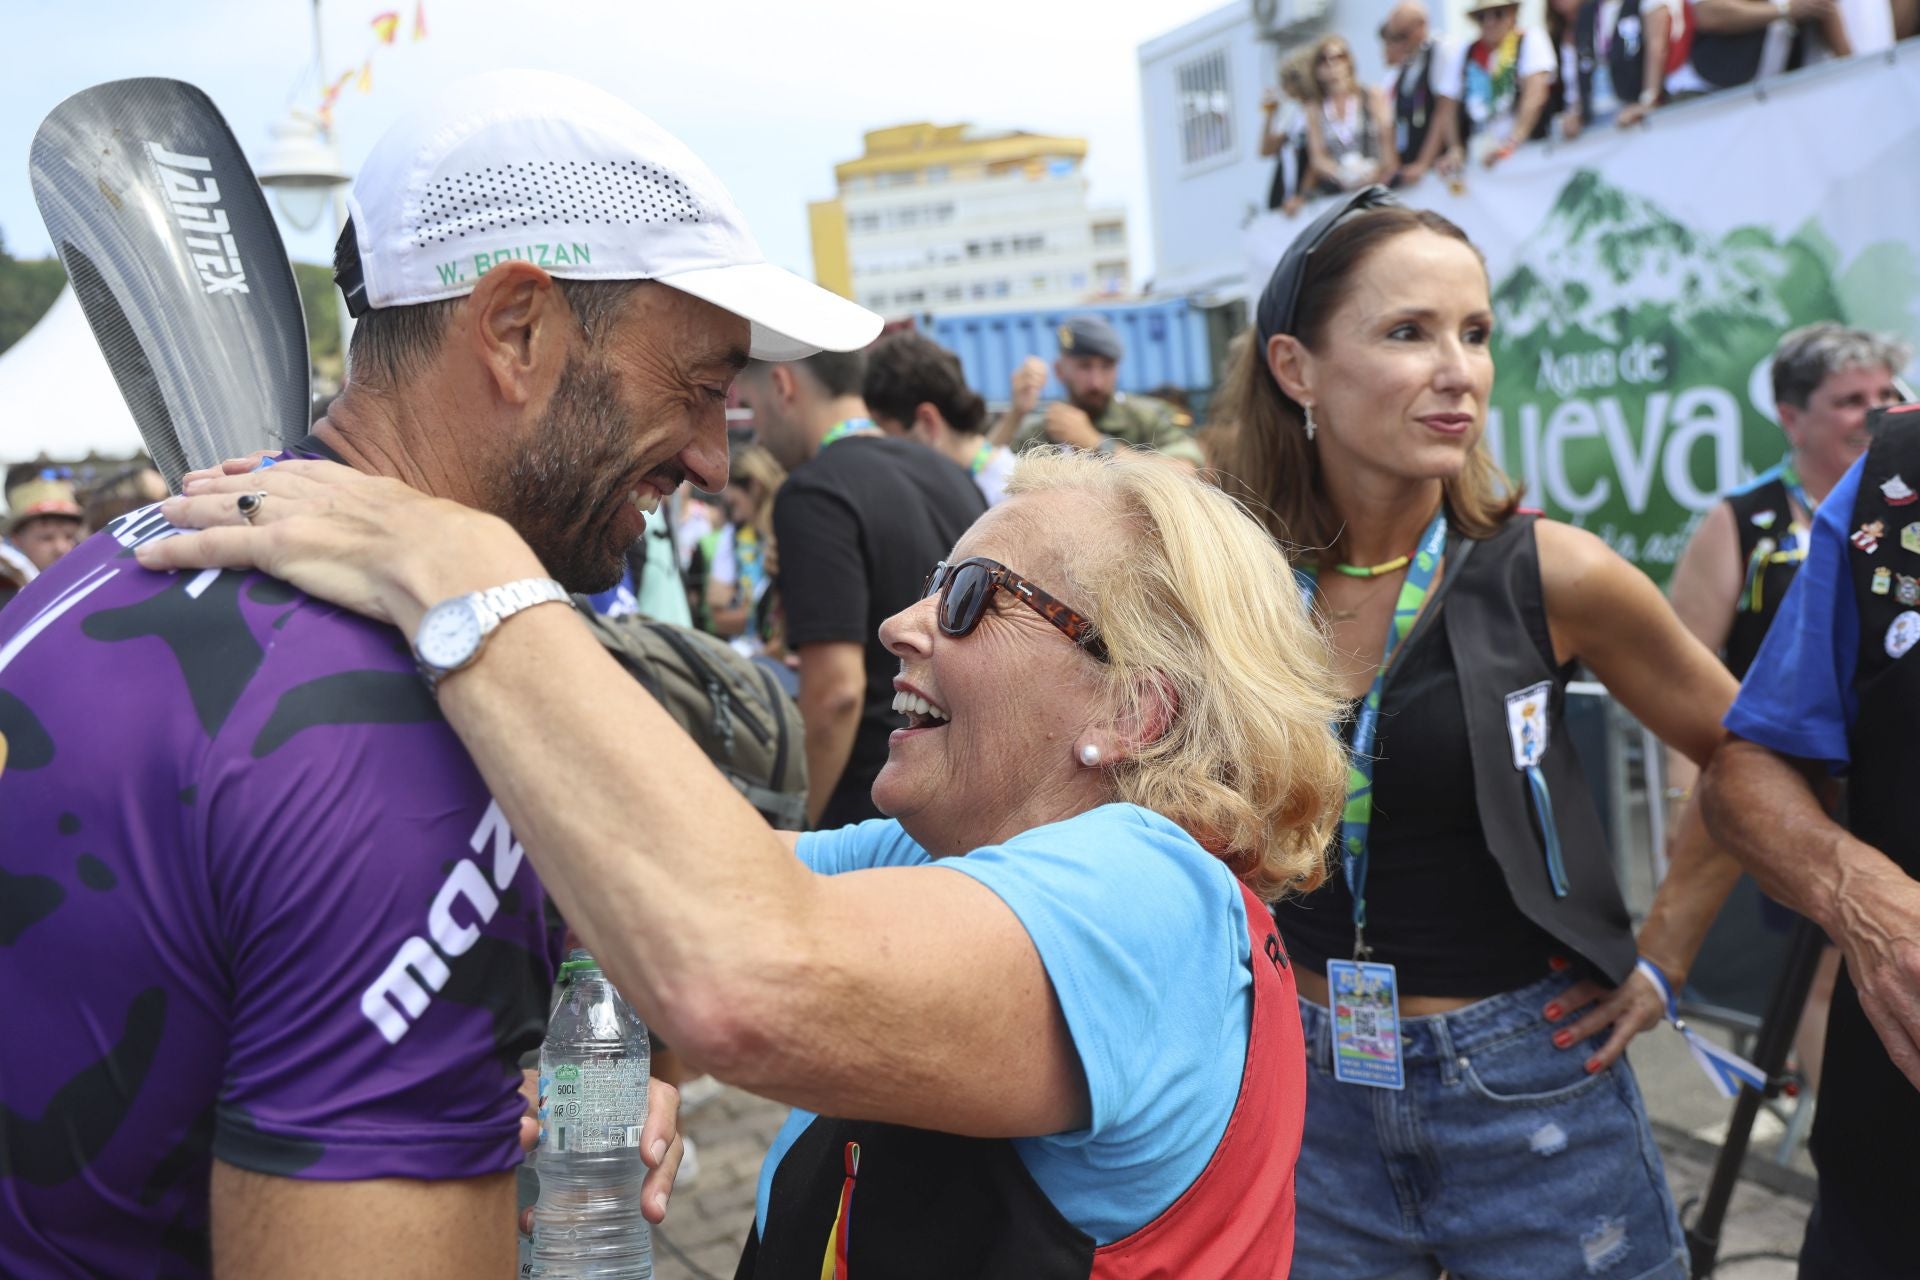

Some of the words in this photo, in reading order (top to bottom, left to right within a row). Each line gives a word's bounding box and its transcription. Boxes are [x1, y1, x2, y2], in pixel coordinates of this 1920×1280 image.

[436, 261, 465, 286] W.
[1536, 347, 1617, 399] Agua
[1618, 336, 1668, 383] de
[557, 1084, 576, 1095] 50CL
